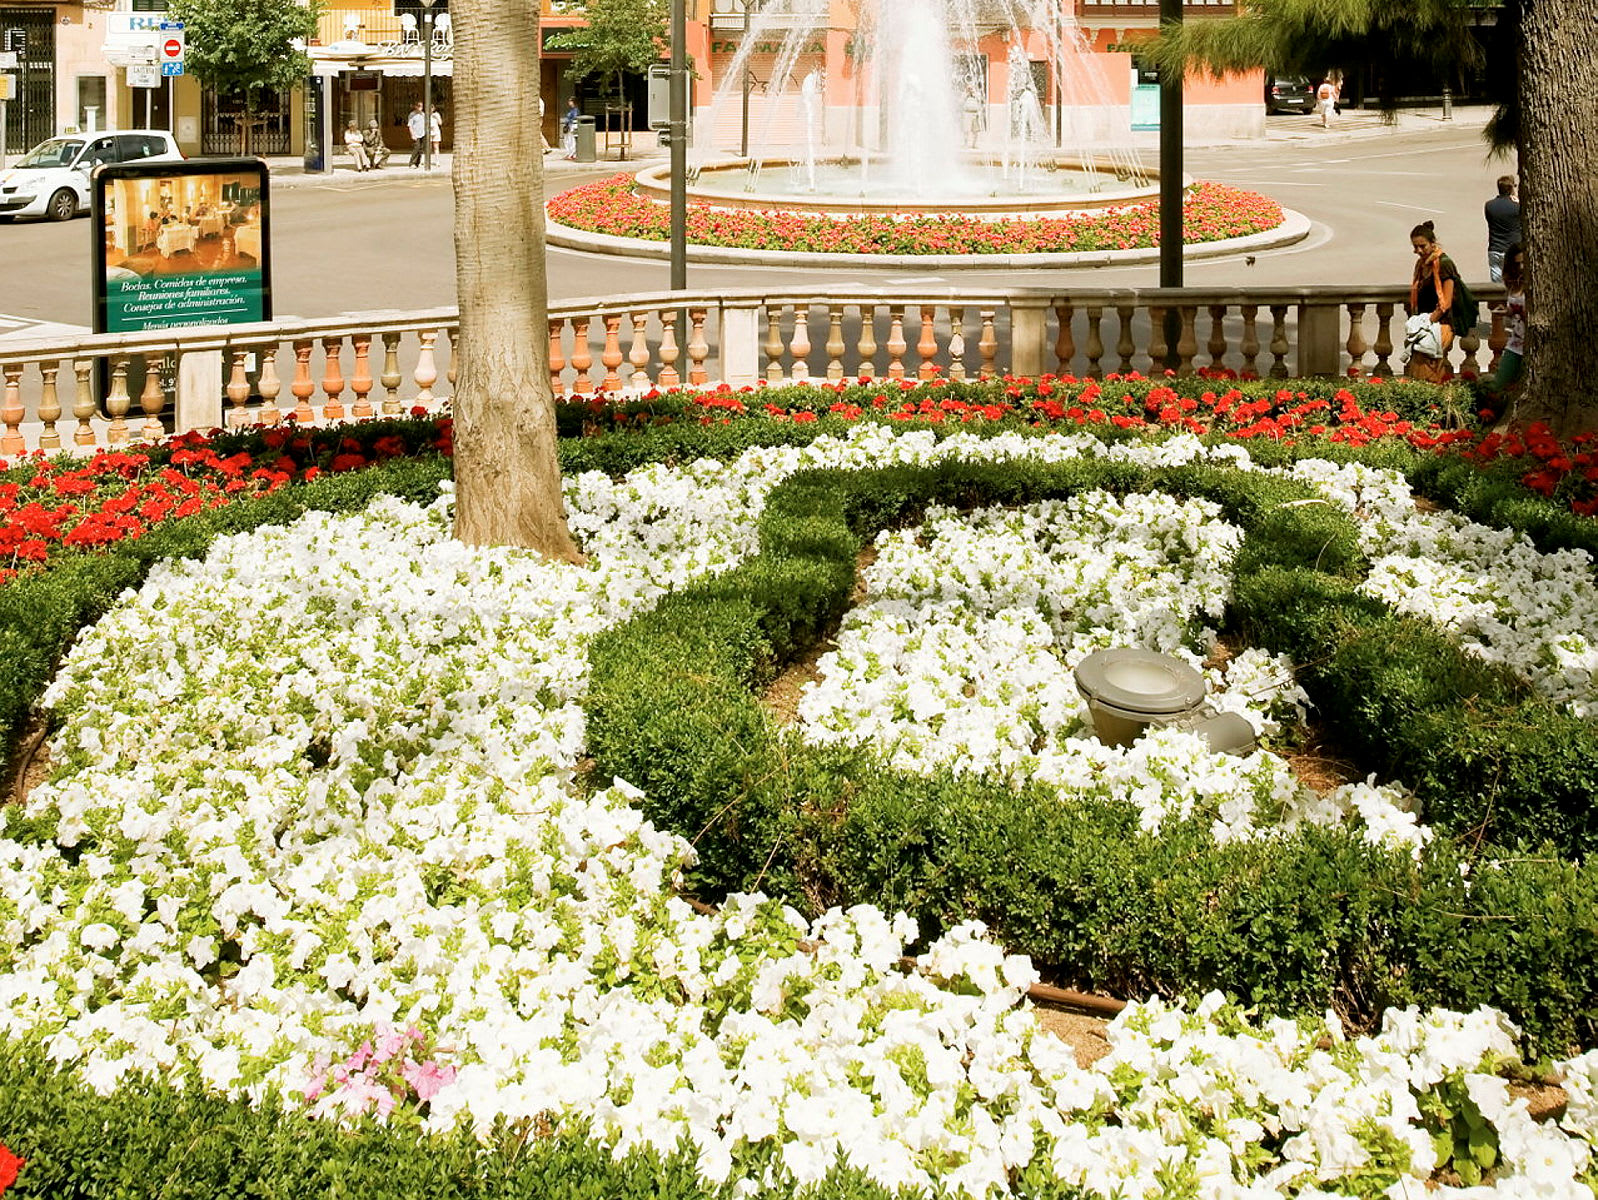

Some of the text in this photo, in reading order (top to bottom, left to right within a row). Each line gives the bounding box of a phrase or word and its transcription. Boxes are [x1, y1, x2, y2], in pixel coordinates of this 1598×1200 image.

[121, 276, 248, 292] Bodas. Comidas de empresa.
[138, 287, 231, 301] Reuniones familiares.
[123, 294, 246, 314] Consejos de administración.
